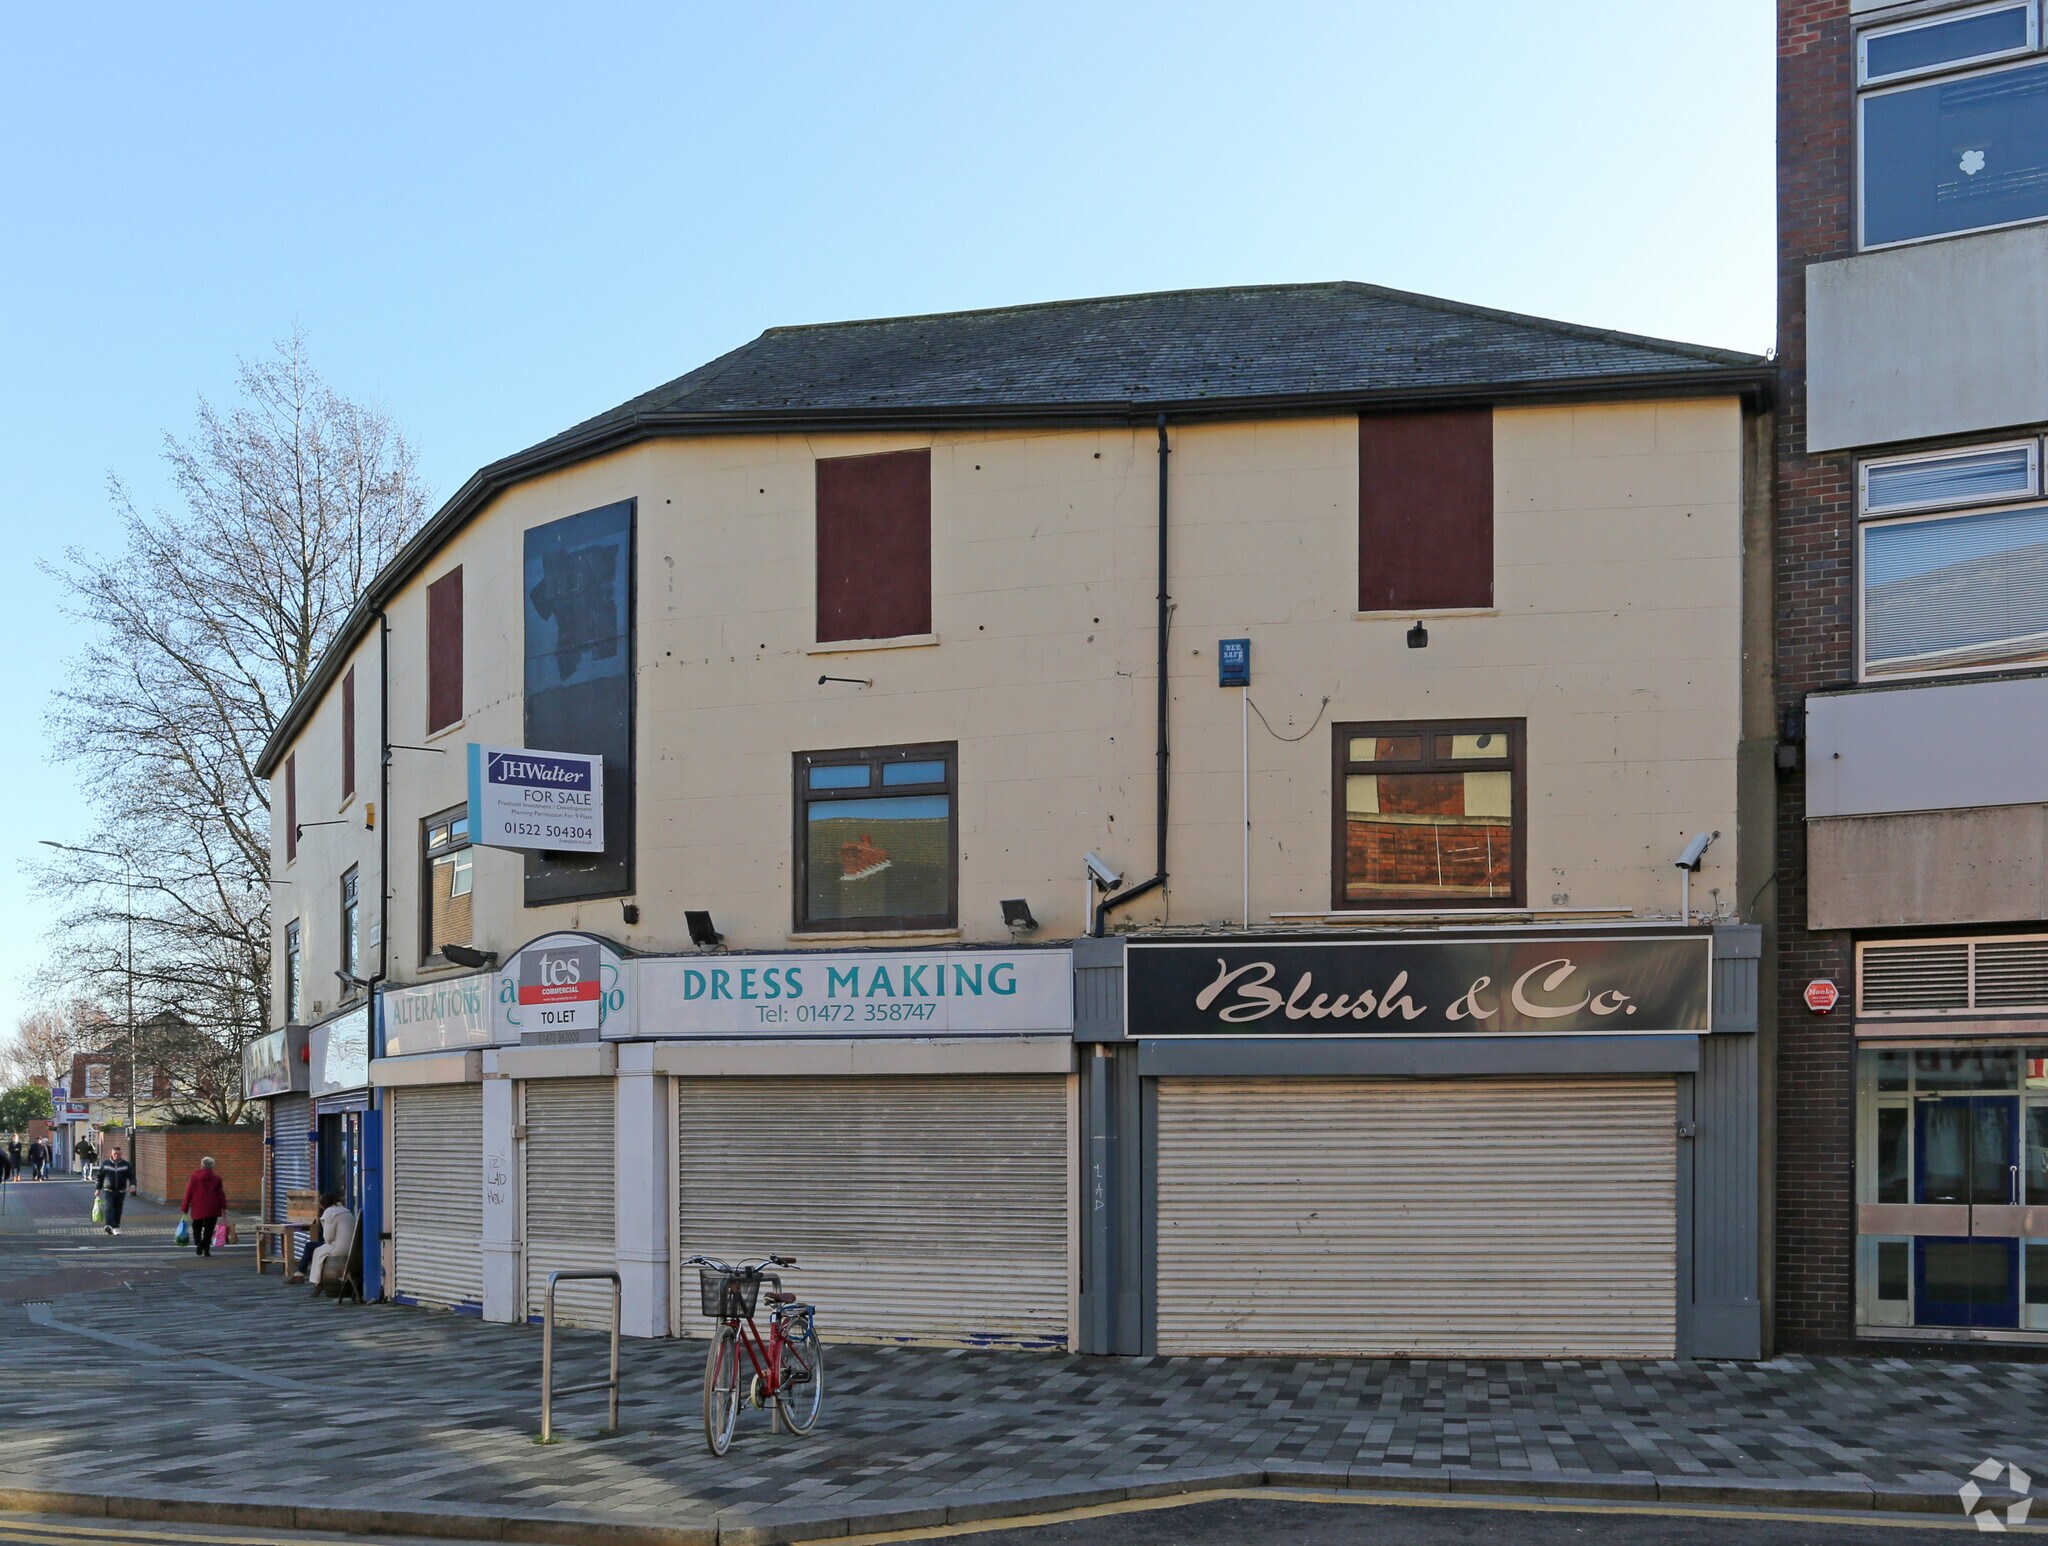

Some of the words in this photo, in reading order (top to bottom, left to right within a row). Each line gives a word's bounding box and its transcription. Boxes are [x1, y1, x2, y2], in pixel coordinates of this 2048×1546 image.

[497, 760, 584, 783] JHWalter
[497, 799, 521, 808] Freehold
[522, 802, 551, 810] Investment
[556, 804, 592, 812] Development
[524, 789, 553, 803] FOR
[558, 792, 592, 806] SALE
[511, 808, 533, 817] Planning
[534, 811, 563, 819] Permission
[504, 821, 541, 836] 01522
[546, 825, 593, 839] 504304
[538, 952, 581, 987] tes
[541, 986, 579, 996] COMMERCIAL
[683, 966, 802, 1001] DRESS
[826, 961, 1018, 999] MAKING
[1195, 957, 1427, 1023] Blush
[1445, 975, 1499, 1022] &
[1511, 957, 1638, 1019] Co.
[392, 984, 482, 1026] ALTERATIONS
[755, 1005, 788, 1024] Tel:
[796, 1004, 856, 1023] 01472
[863, 1002, 937, 1022] 358747
[541, 1011, 555, 1025] TO
[557, 1009, 576, 1024] LET
